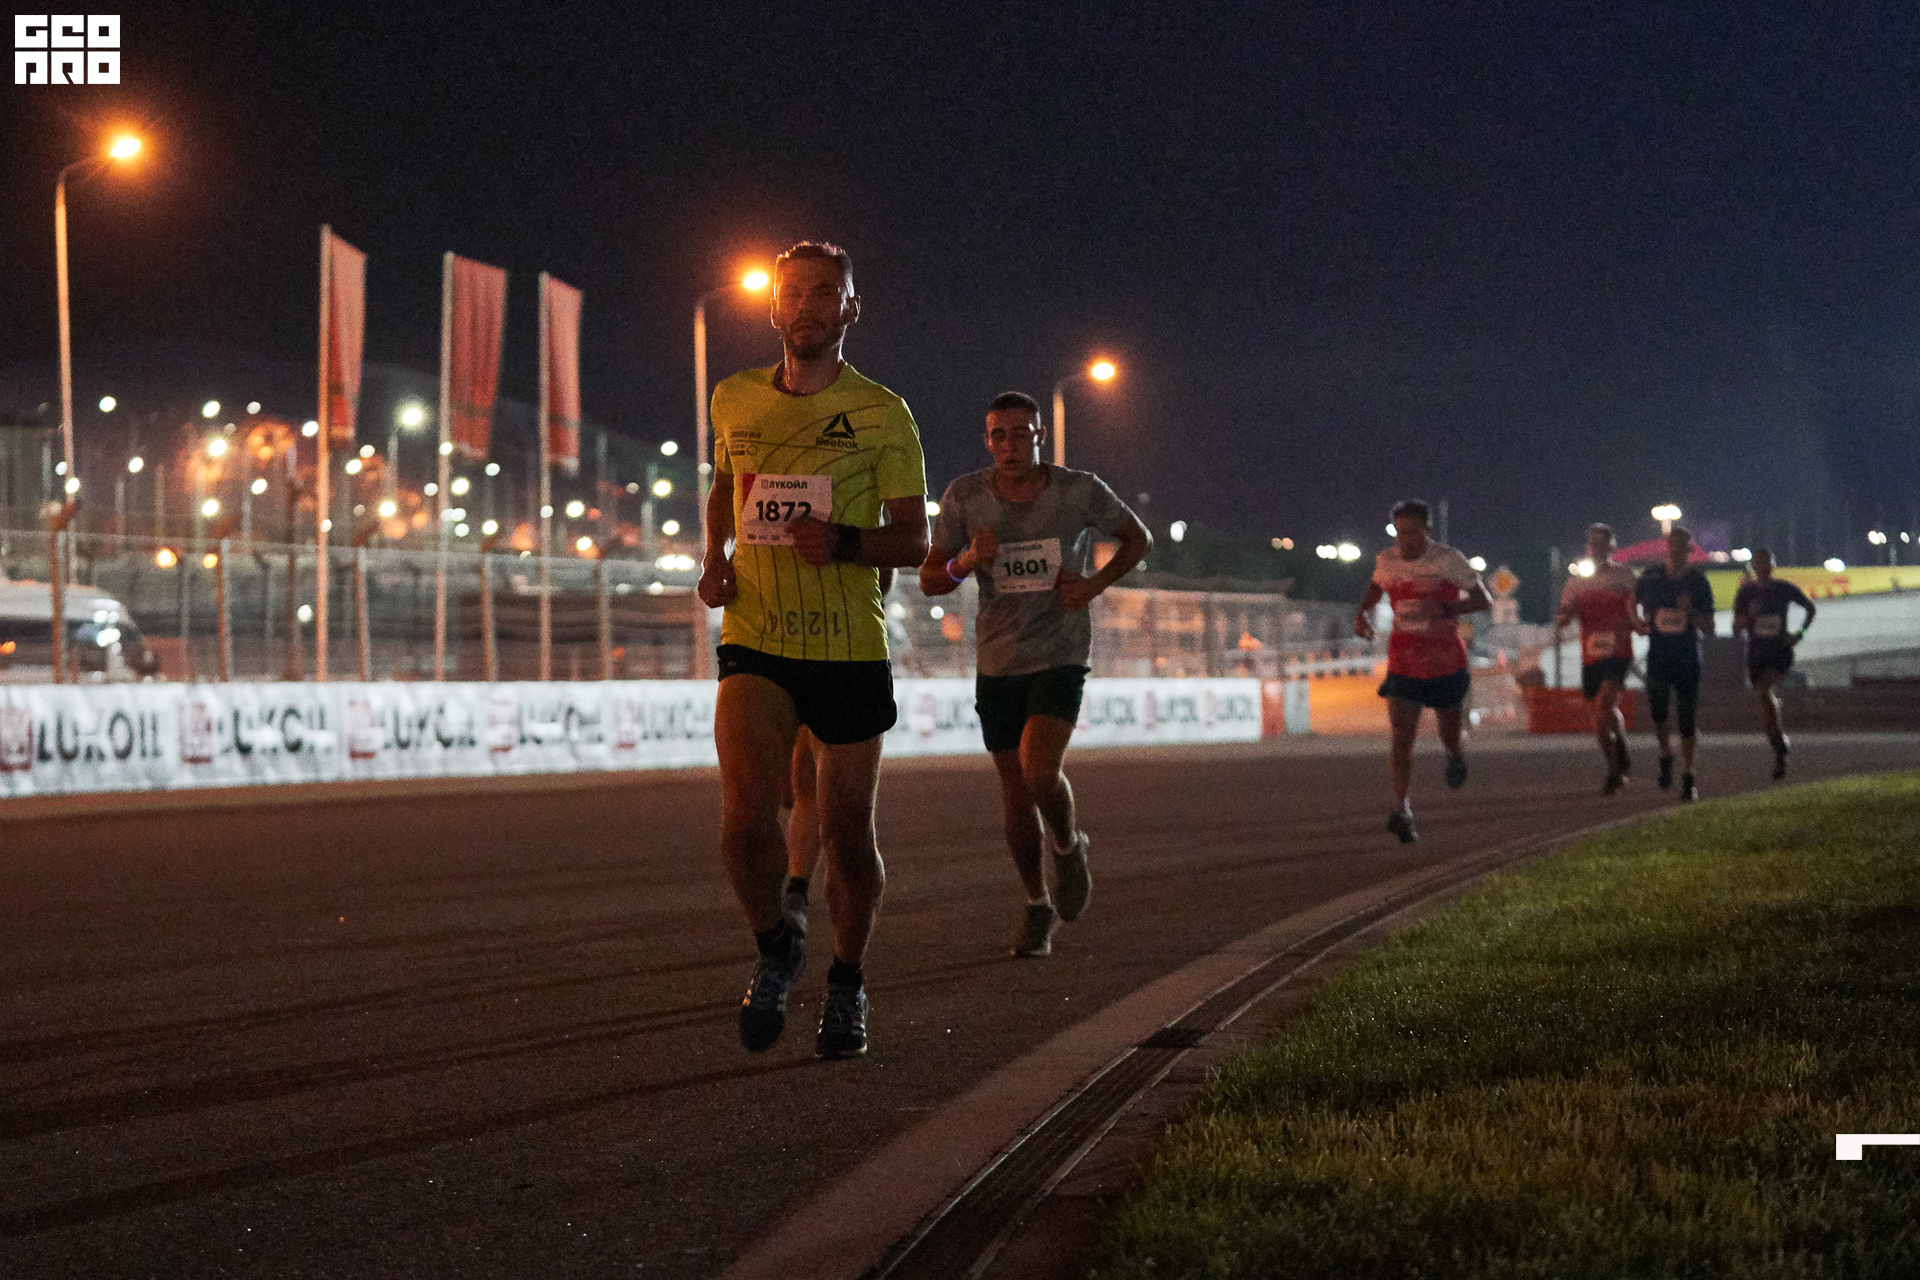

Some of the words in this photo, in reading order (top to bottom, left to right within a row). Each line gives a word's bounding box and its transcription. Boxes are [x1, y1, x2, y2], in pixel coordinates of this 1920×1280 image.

[815, 437, 859, 450] Reebok
[768, 480, 808, 489] ЛУКОЙЛ
[756, 500, 812, 521] 1872
[1003, 558, 1048, 577] 1801
